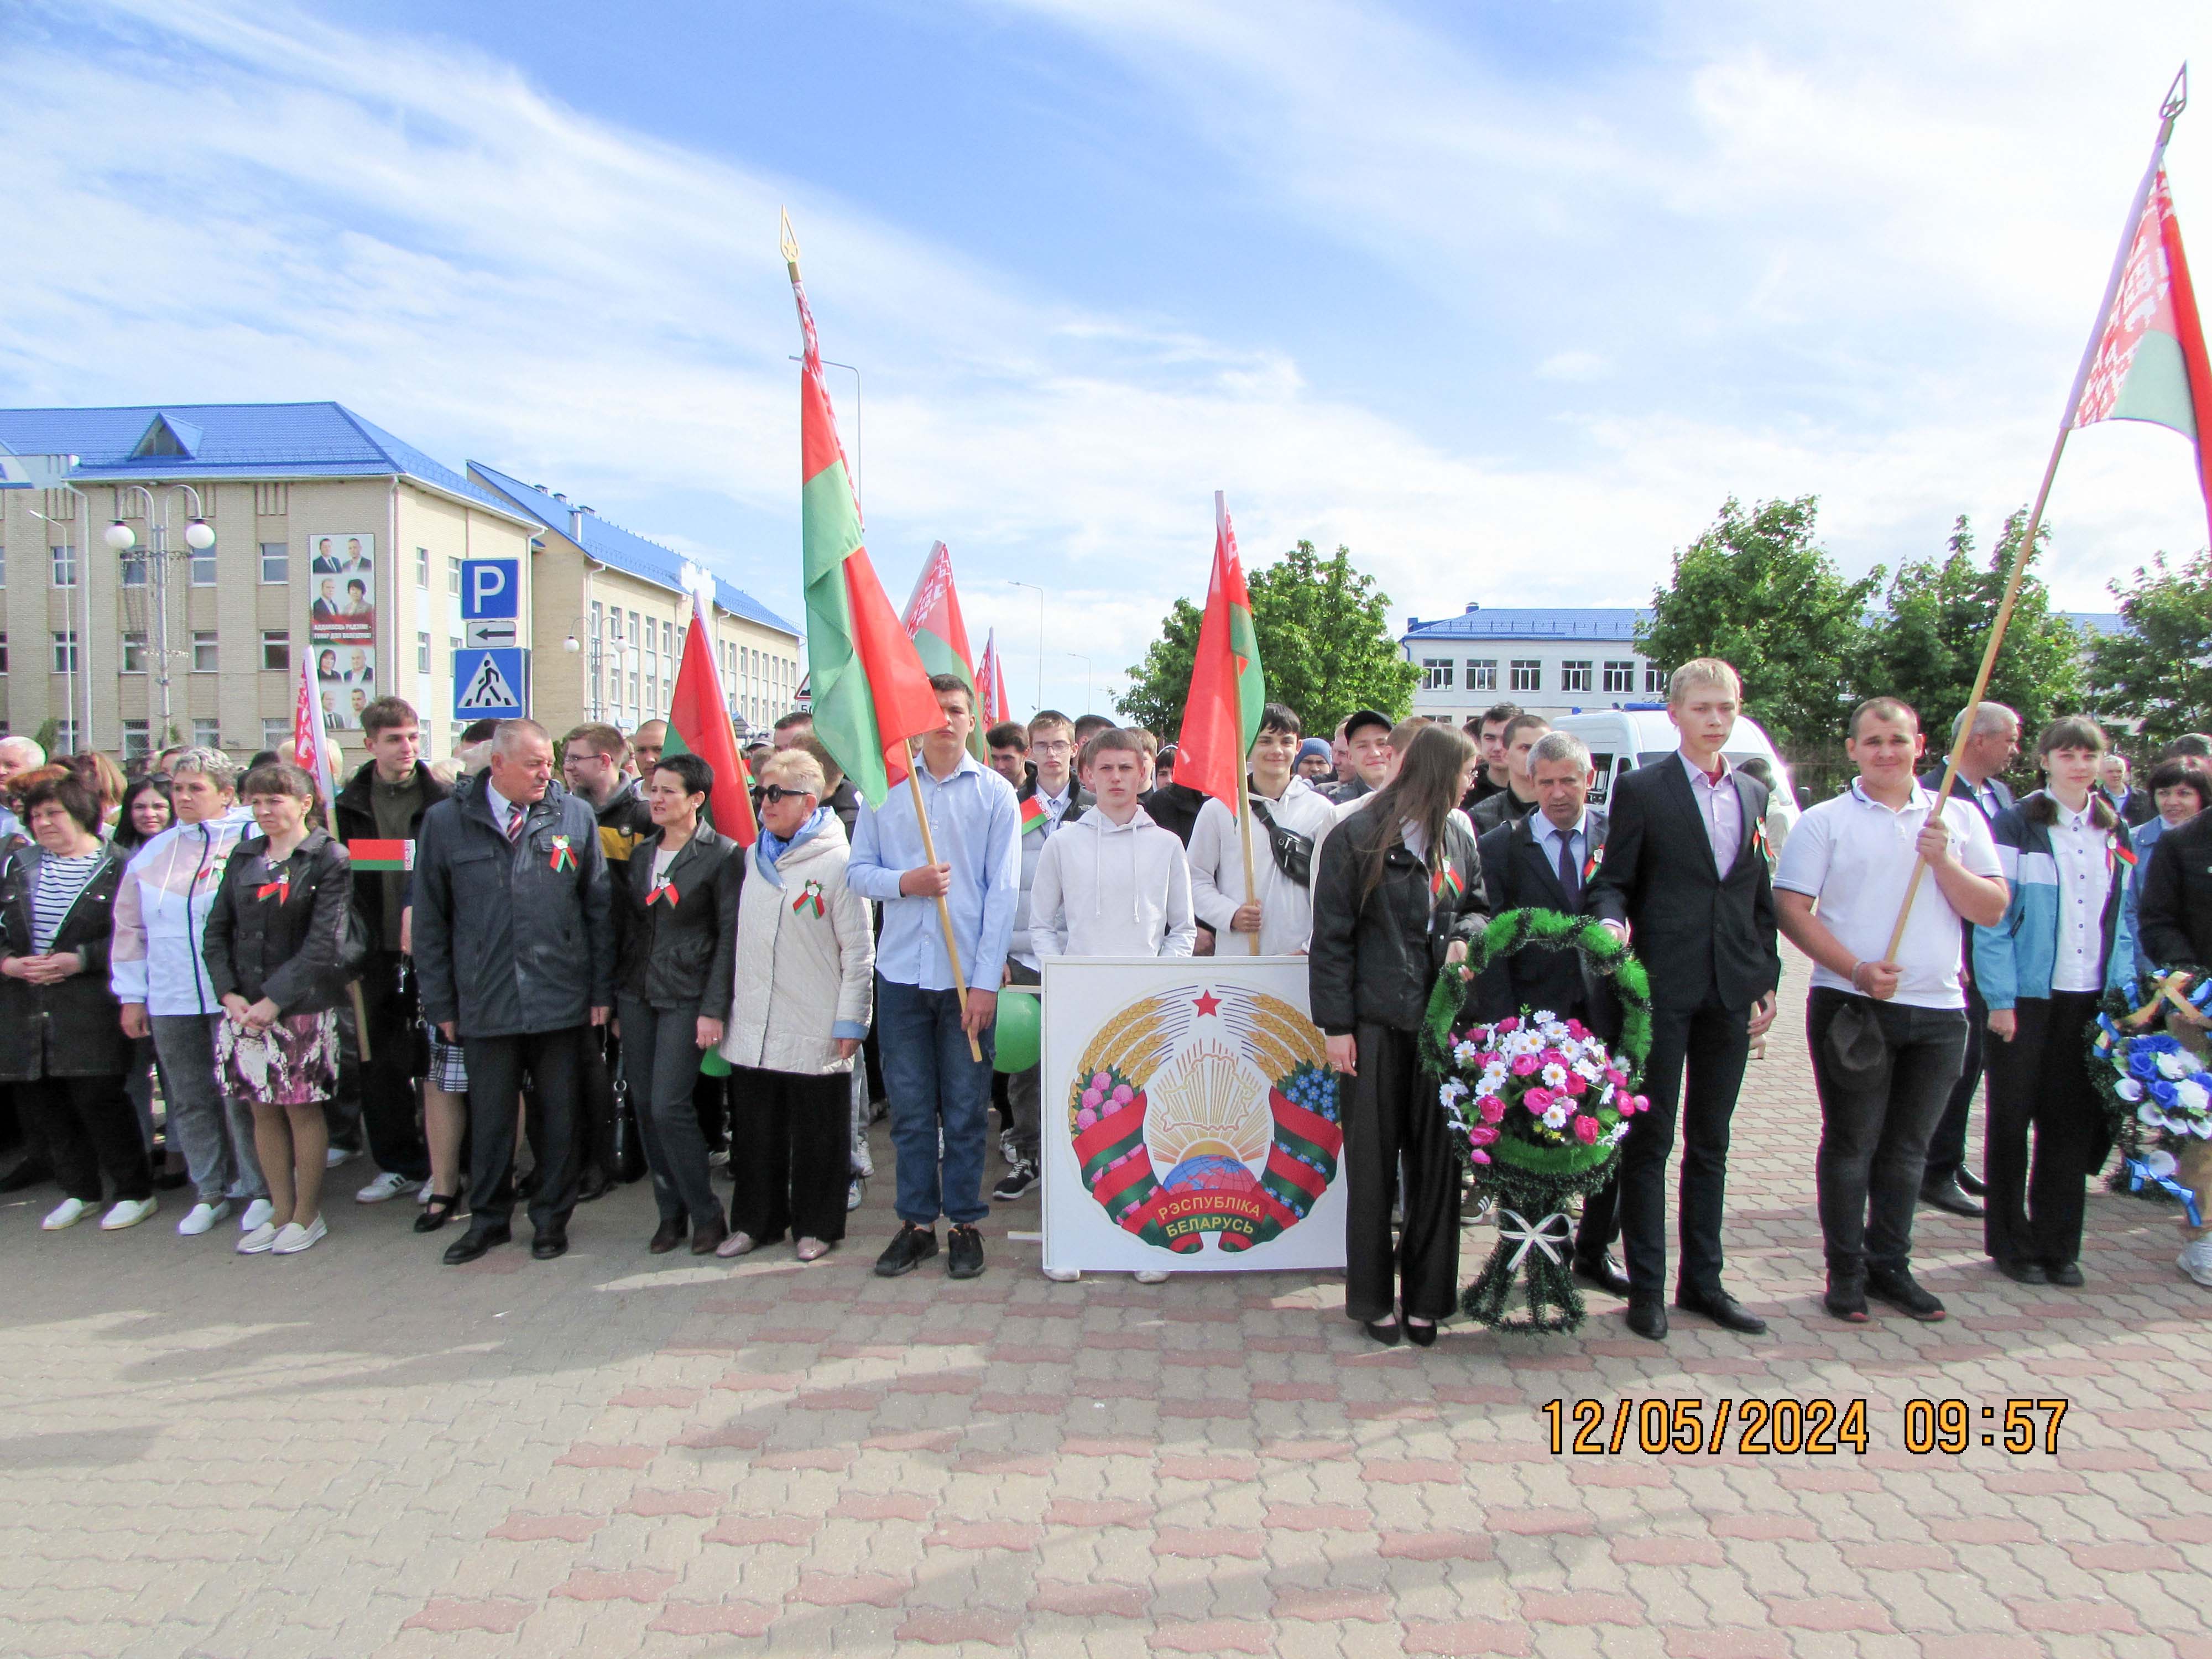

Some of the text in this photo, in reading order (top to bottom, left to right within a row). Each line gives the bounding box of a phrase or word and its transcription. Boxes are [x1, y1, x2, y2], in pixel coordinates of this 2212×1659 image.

[474, 566, 505, 613] P
[1158, 1196, 1260, 1220] РЭСПУБЛІКА
[1165, 1217, 1254, 1238] БЕЛАРУСЬ
